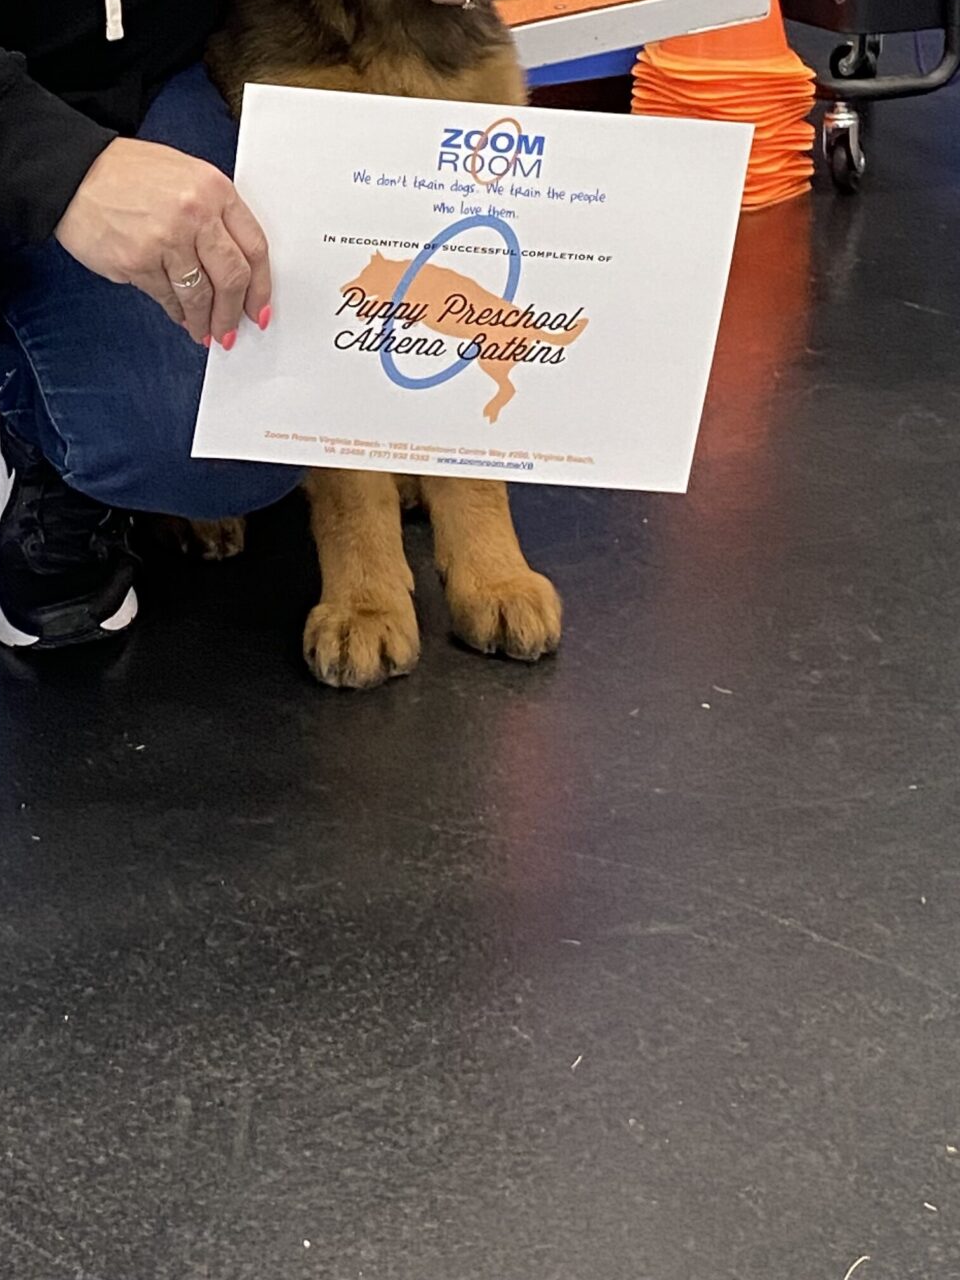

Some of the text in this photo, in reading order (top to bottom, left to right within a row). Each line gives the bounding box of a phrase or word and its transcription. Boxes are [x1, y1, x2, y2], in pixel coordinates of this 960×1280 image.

[440, 128, 545, 156] ZOOM
[437, 151, 542, 178] ROOM
[353, 169, 607, 204] We don't train dogs. We train the people
[433, 201, 520, 219] who love them.
[323, 234, 614, 263] IN RECOGNITION OF SUCCESSFUL COMPLETION OF
[335, 286, 585, 332] Puppy Preschool
[333, 327, 447, 357] Athena
[264, 430, 290, 440] Zoom
